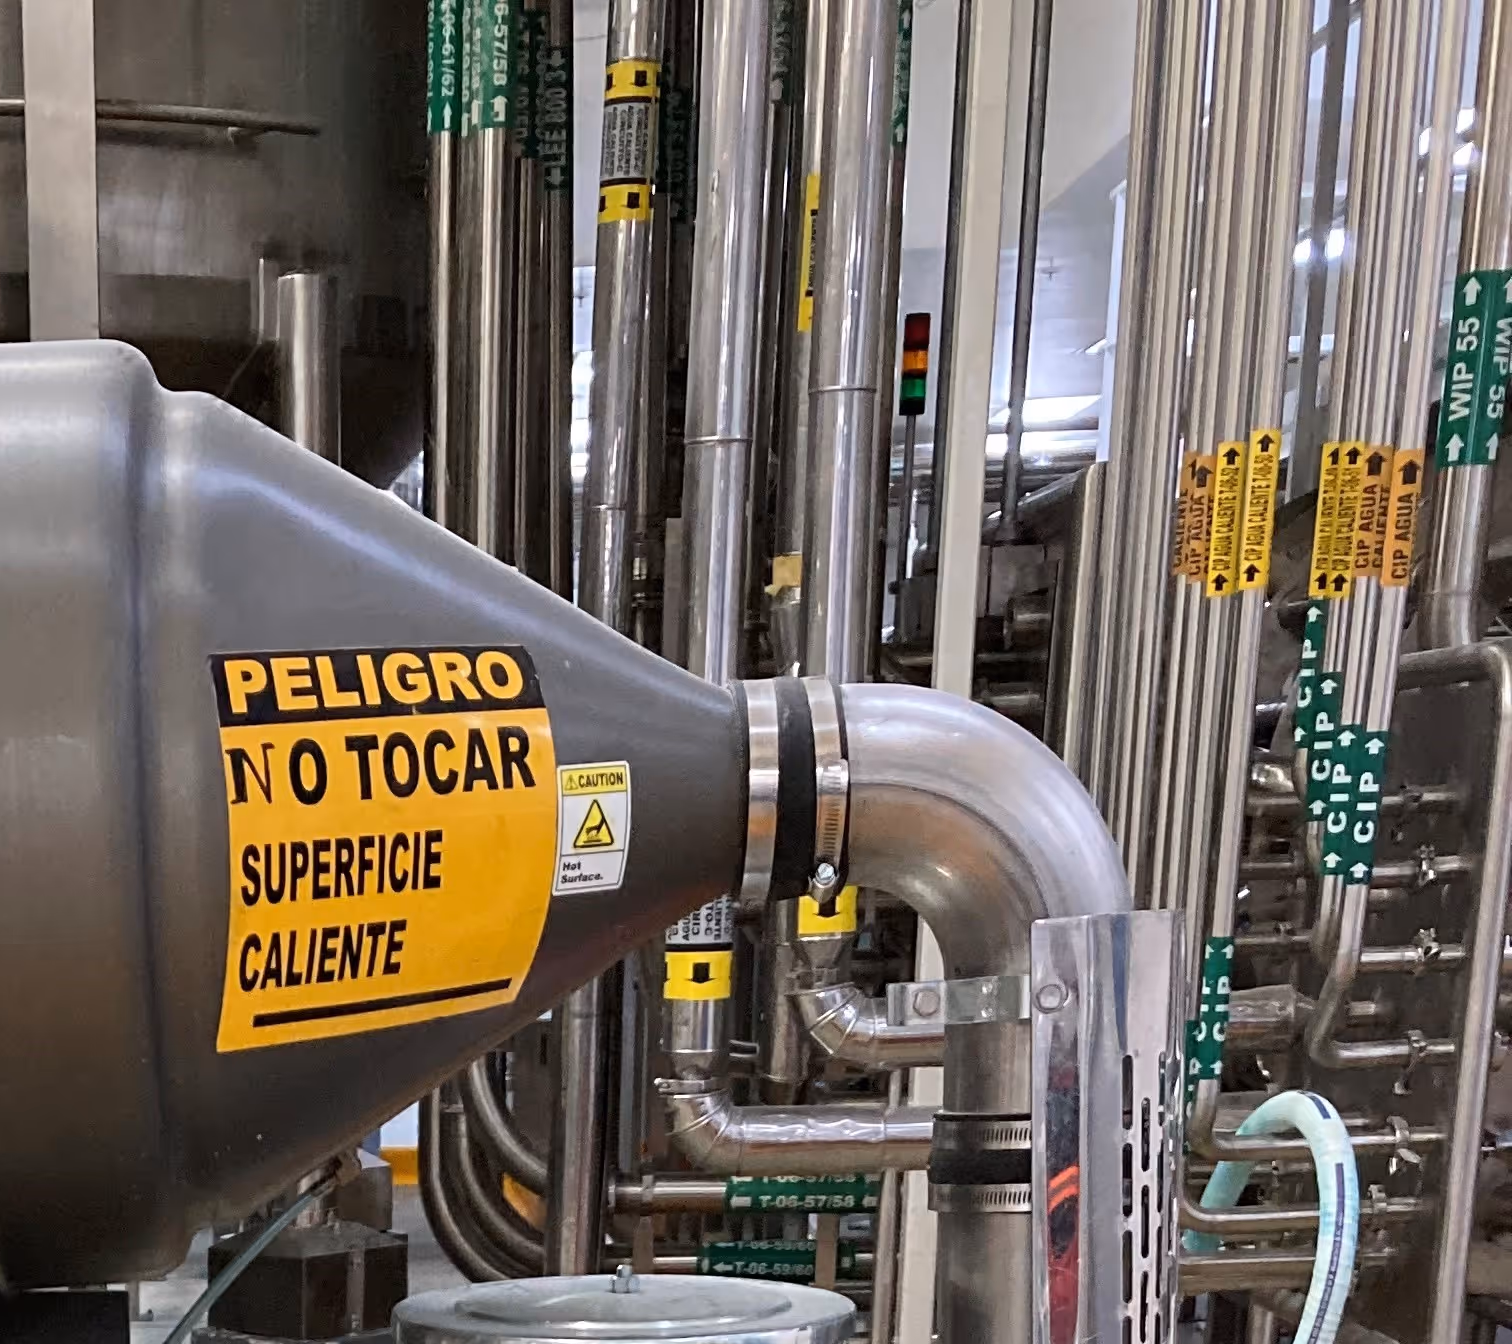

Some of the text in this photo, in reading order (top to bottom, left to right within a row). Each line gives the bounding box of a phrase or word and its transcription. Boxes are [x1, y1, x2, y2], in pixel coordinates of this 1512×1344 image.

[493, 0, 509, 86] 6-57/58
[1448, 316, 1480, 423] WIP 55
[1487, 384, 1506, 420] 55
[1245, 525, 1266, 546] AGUA
[1248, 484, 1270, 523] CALIENTE
[1354, 484, 1378, 569] CIP AGUA
[1391, 492, 1414, 579] CIP AGUA
[223, 650, 523, 715] PELIGRO
[1296, 639, 1317, 708] CIP
[225, 725, 536, 805] NO TOCAR
[578, 772, 623, 788] CAUTION
[1311, 711, 1335, 781] CIP
[1327, 763, 1352, 834] CIP
[1353, 771, 1379, 844] CIP
[240, 829, 443, 907] SUPERFICIE
[562, 861, 581, 871] Hot
[238, 919, 407, 992] CALIENTE
[758, 1195, 855, 1208] T-06-57/58
